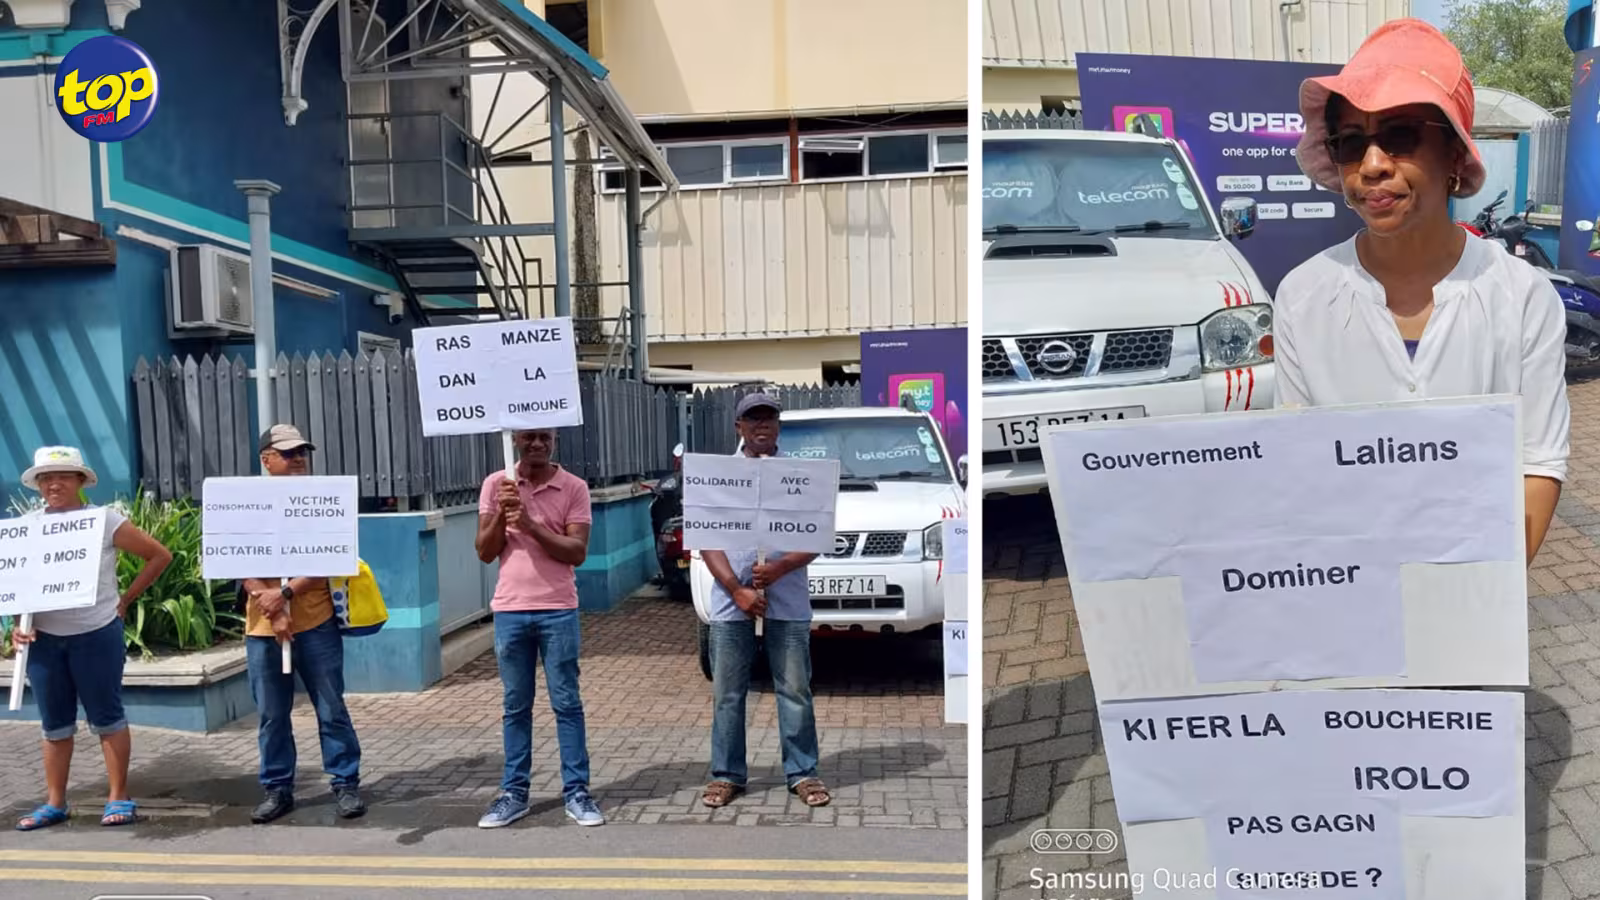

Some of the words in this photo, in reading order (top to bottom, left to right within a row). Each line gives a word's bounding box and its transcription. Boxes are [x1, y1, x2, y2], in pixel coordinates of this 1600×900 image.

[1208, 112, 1306, 133] SUPER
[1222, 147, 1243, 157] one
[1246, 147, 1269, 158] app
[1271, 146, 1288, 157] for
[1077, 187, 1169, 204] telecom
[436, 335, 471, 352] RAS
[501, 328, 562, 346] MANZE
[439, 372, 476, 388] DAN
[523, 367, 546, 381] LA
[436, 405, 486, 421] BOUS
[508, 398, 568, 413] DIMOUNE
[855, 448, 920, 460] telecom
[1082, 440, 1263, 471] Gouvernement
[1335, 437, 1459, 466] Lalians
[685, 476, 753, 488] SOLIDARITE
[780, 477, 810, 486] AVEC
[787, 488, 802, 496] LA
[205, 503, 273, 511] CONSOMATEUR
[289, 496, 340, 506] VICTIME
[284, 508, 345, 518] DECISION
[42, 518, 97, 536] LENKET
[685, 521, 752, 531] BOUCHERIE
[769, 522, 818, 534] IROLO
[20, 556, 27, 568] ?
[43, 552, 51, 564] 9
[54, 548, 87, 563] MOIS
[205, 546, 273, 556] DICTATIRE
[281, 545, 349, 555] L'ALLIANCE
[829, 579, 853, 594] RFZ
[860, 579, 874, 593] 14
[1222, 563, 1361, 593] Dominer
[42, 582, 65, 594] FINI
[67, 580, 80, 592] ??
[1122, 717, 1157, 741] KI
[1166, 716, 1233, 740] FER
[1240, 713, 1286, 737] LA
[1324, 710, 1493, 731] BOUCHERIE
[1354, 767, 1470, 790] IROLO
[1227, 816, 1283, 835] PAS
[1290, 813, 1376, 834] GAGN
[1365, 868, 1383, 888] ?
